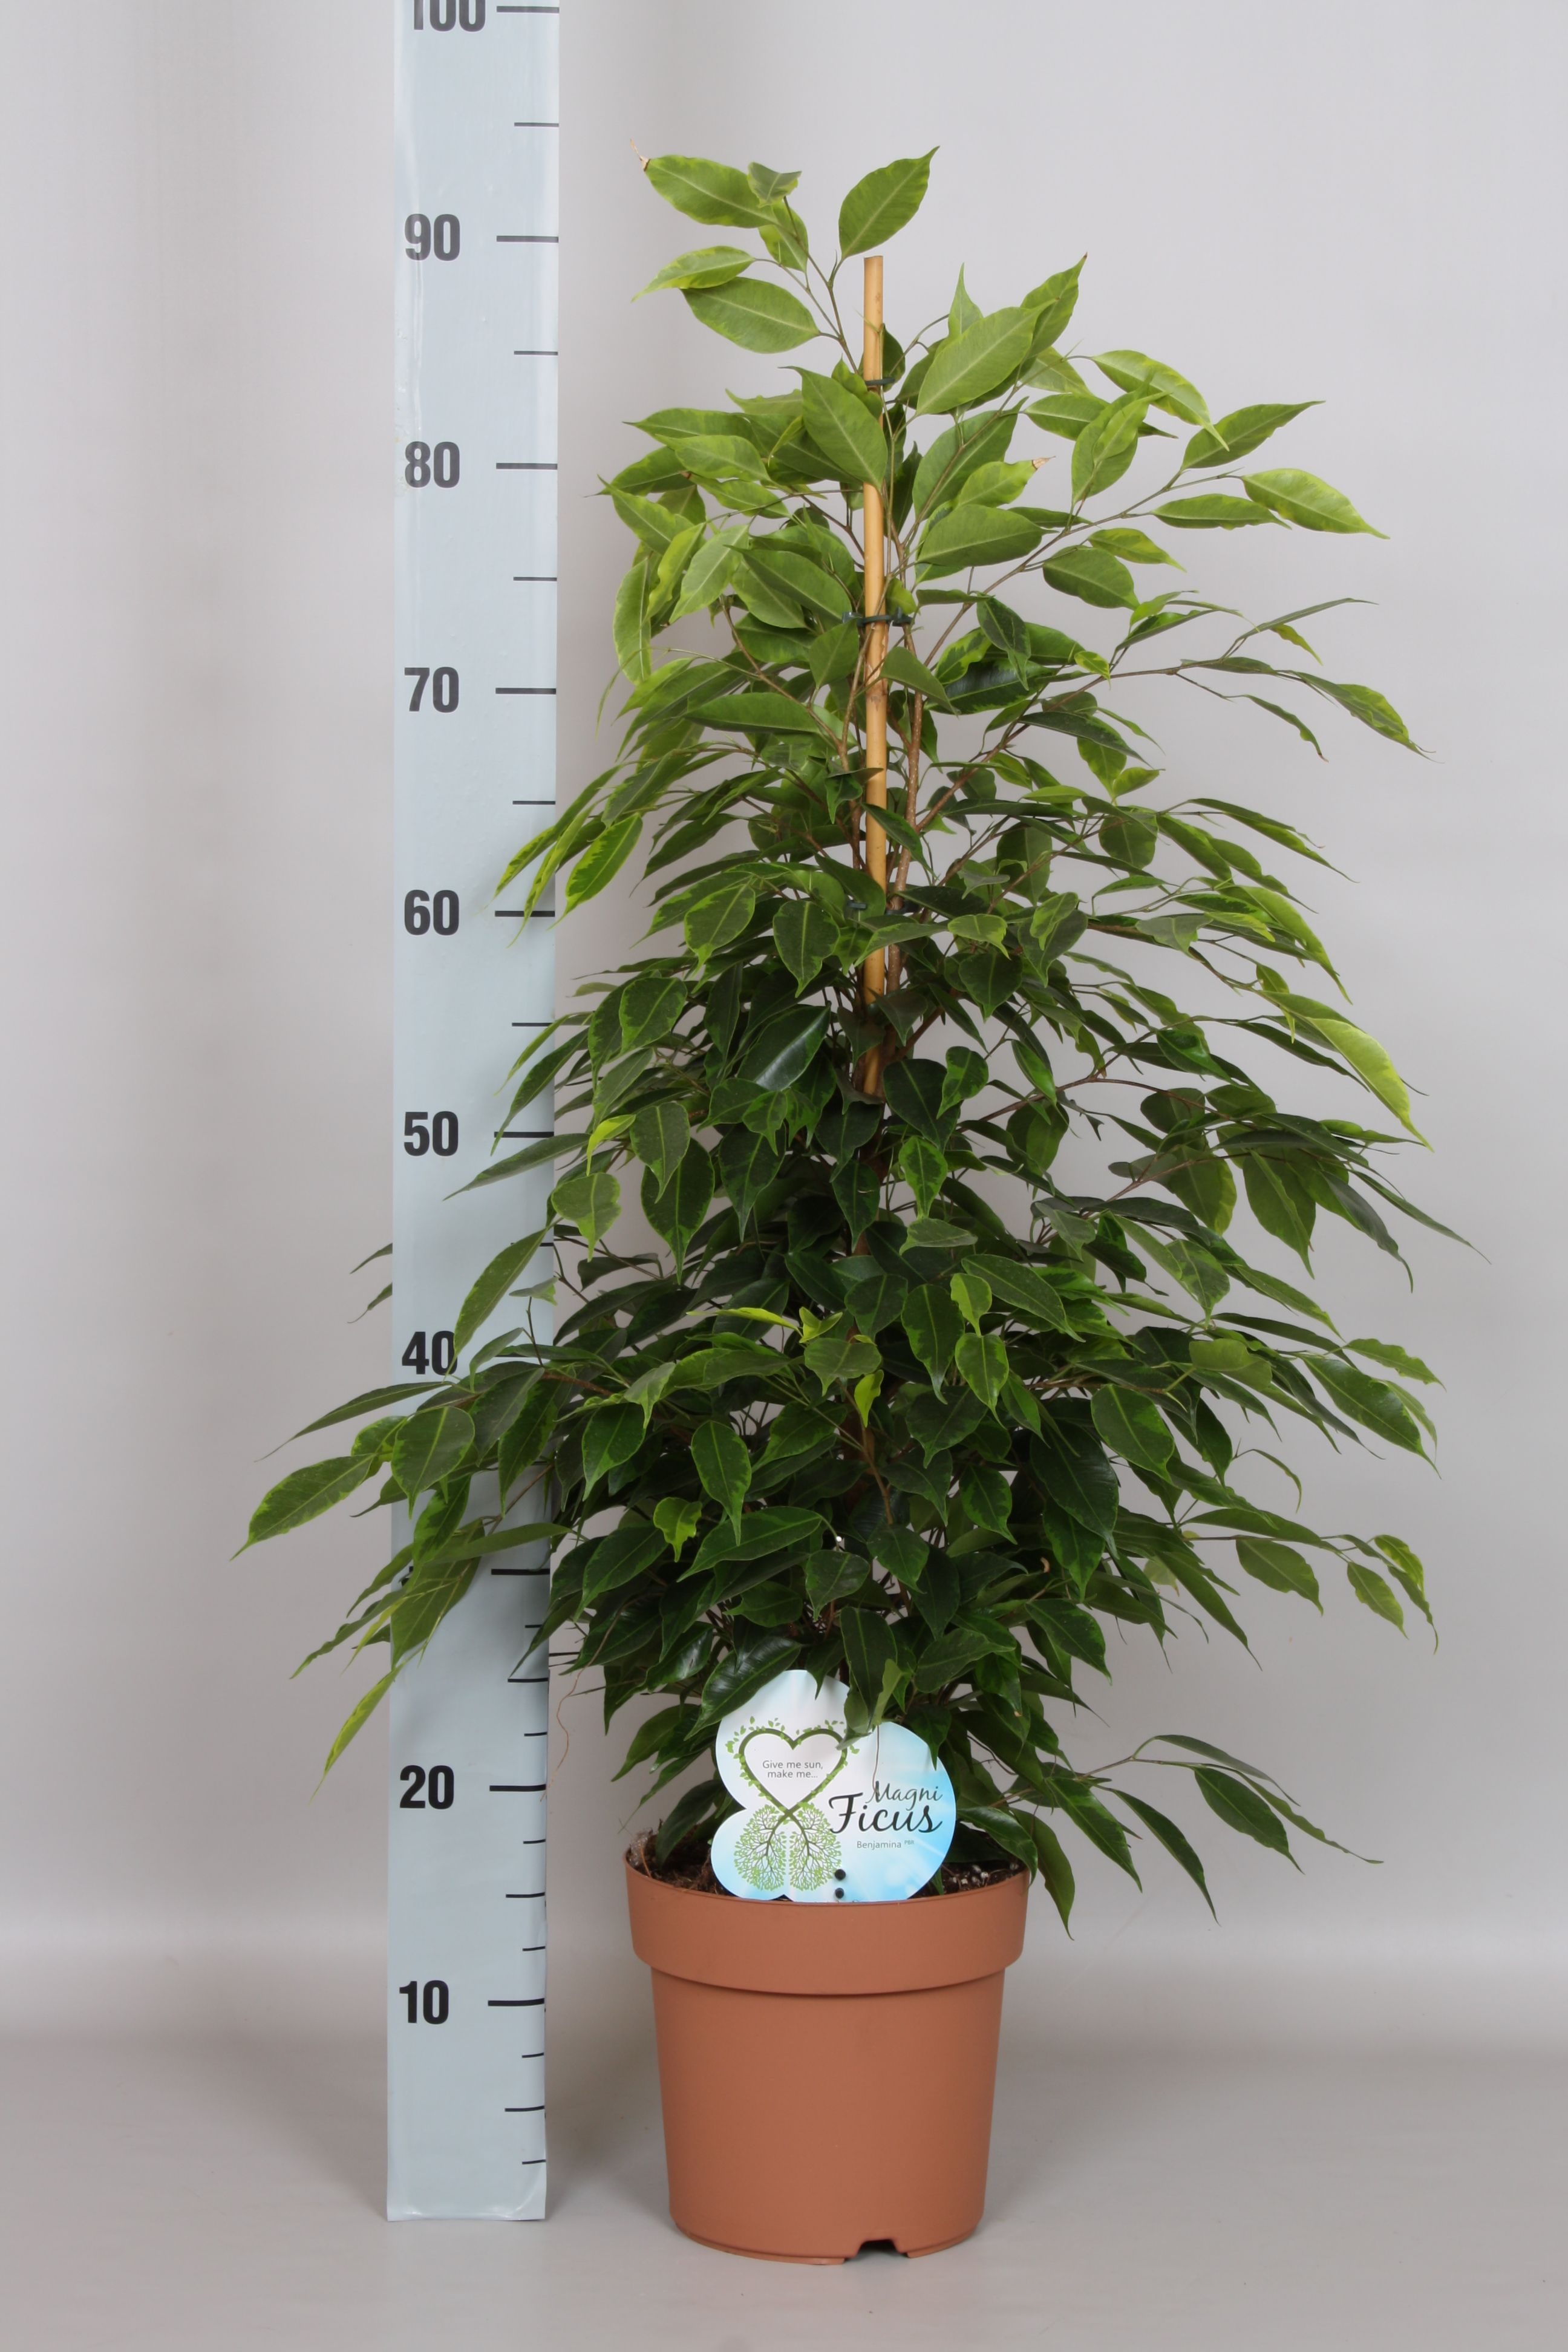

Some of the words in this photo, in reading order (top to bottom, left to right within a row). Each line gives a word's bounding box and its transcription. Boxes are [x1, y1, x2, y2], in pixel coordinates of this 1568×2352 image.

[414, 0, 486, 31] 100
[405, 214, 460, 261] 90
[405, 441, 460, 488] 80
[404, 667, 459, 713] 70
[404, 889, 460, 936] 60
[403, 1111, 459, 1157] 50
[401, 1330, 458, 1376] 40
[399, 1764, 455, 1810] 20
[762, 1760, 783, 1769] Give
[804, 1762, 823, 1770] sun,
[767, 1769, 793, 1778] make
[828, 1792, 943, 1834] Ficus
[866, 1781, 943, 1811] Magni
[857, 1840, 902, 1851] Benjamina
[399, 1979, 449, 2025] 10
